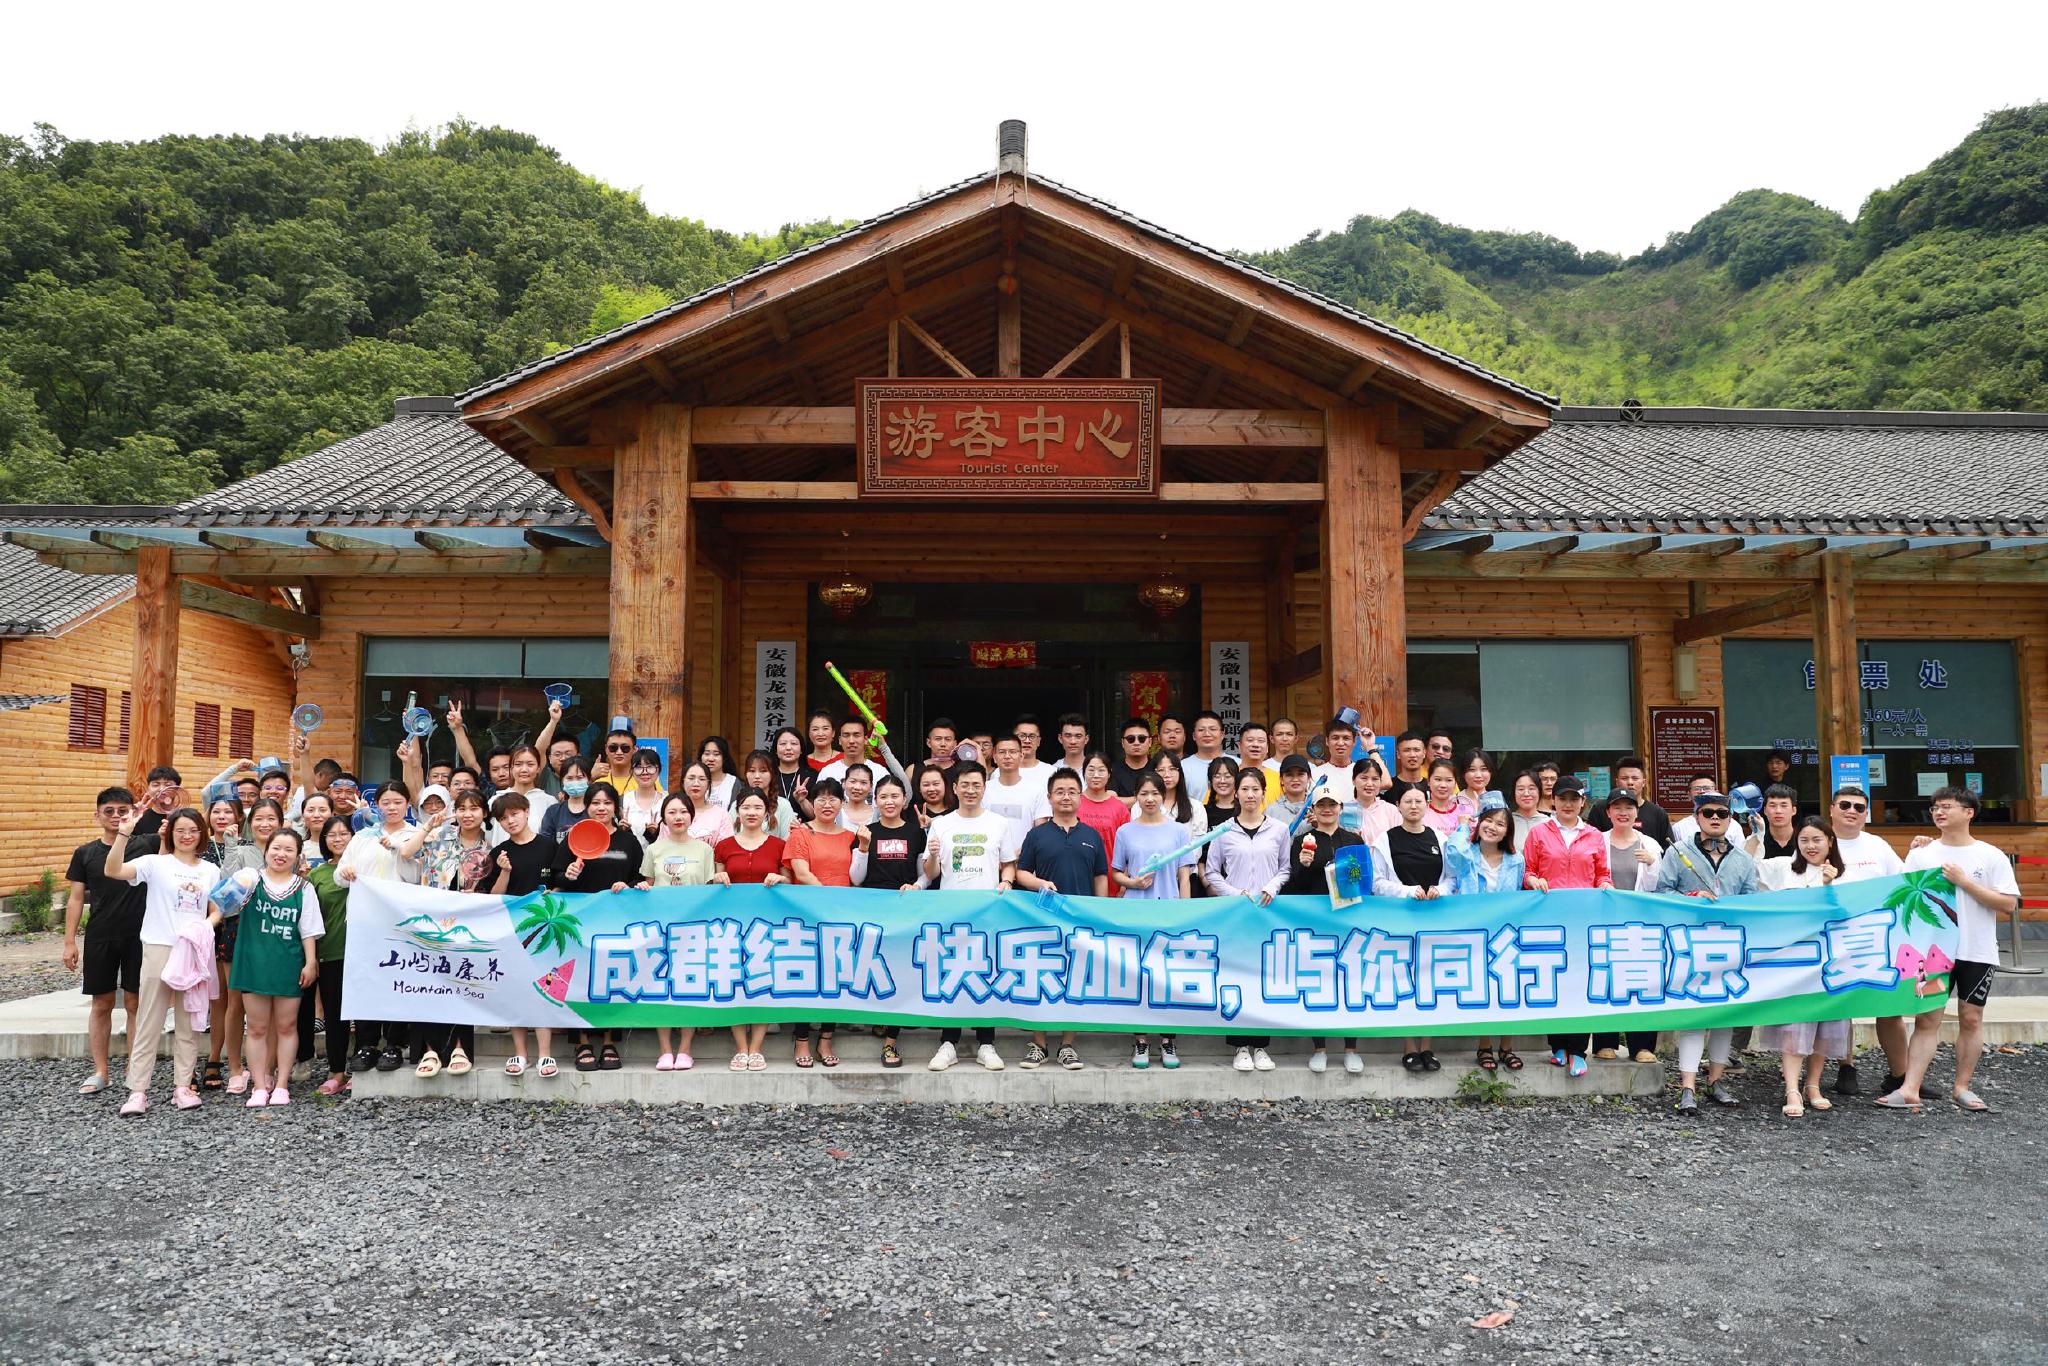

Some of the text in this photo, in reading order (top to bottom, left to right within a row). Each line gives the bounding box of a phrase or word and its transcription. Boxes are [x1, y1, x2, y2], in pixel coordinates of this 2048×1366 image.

[885, 405, 1133, 460] 游客中心
[960, 463, 1059, 474] Tourist Center
[763, 648, 787, 752] 安徽龙溪谷
[1219, 648, 1241, 757] 安徽山水画廊休
[1864, 708, 1926, 723] 160元/人
[256, 898, 298, 922] SPORT
[588, 918, 897, 1002] 成群结队
[1262, 923, 1567, 1011] 屿你同行
[1587, 909, 1899, 1004] 清凉一夏
[393, 980, 453, 995] Mountain
[463, 987, 486, 999] Sea
